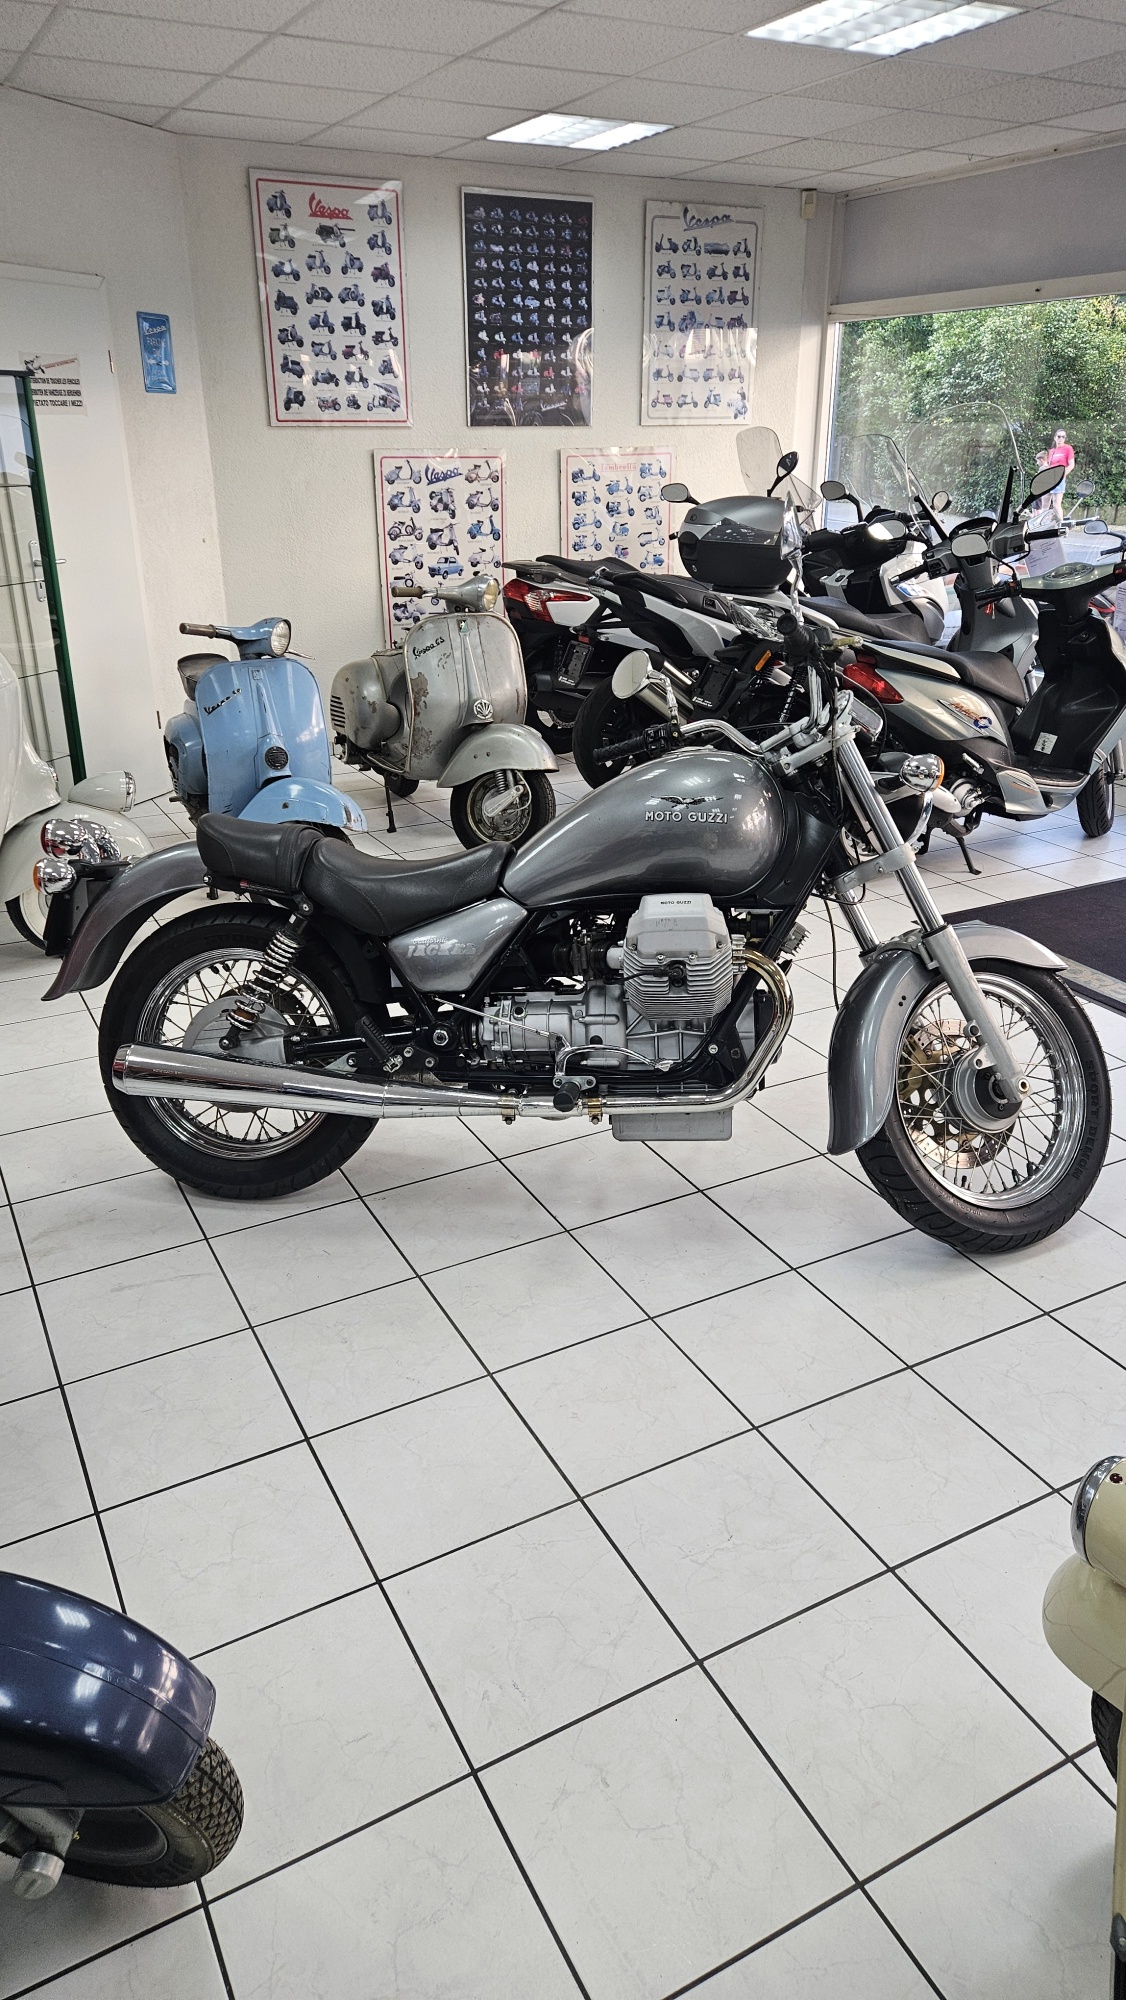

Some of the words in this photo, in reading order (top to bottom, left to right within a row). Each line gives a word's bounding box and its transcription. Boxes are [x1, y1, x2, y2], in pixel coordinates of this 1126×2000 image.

[308, 192, 353, 220] Vespa
[683, 206, 734, 232] Vespa
[144, 321, 167, 336] Vespa
[425, 463, 463, 486] Vespa
[413, 643, 435, 660] Vespa
[203, 696, 233, 716] Vespa
[645, 811, 682, 822] MOTO
[688, 812, 728, 824] GUZZI
